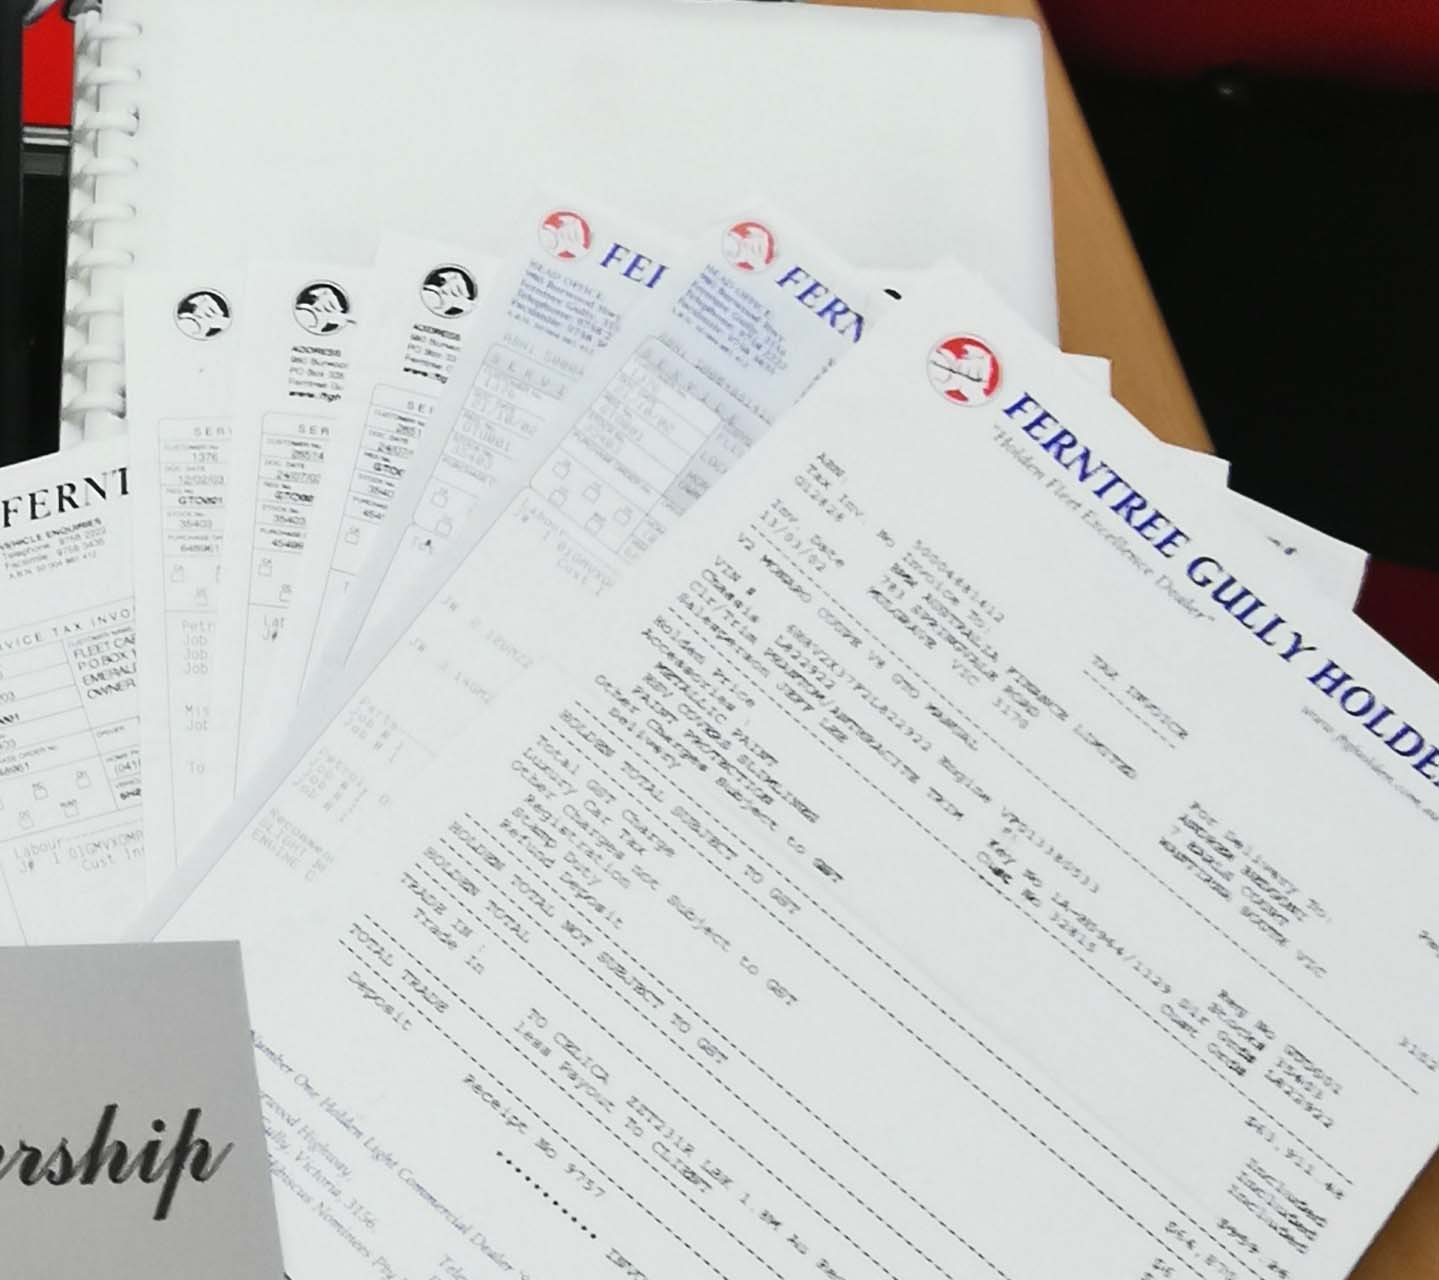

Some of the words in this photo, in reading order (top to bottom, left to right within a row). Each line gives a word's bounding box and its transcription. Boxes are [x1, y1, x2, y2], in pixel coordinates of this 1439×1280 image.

[51, 623, 83, 637] TAX
[1002, 391, 1191, 559] FERNTREE
[1186, 556, 1317, 663] GULLY
[1306, 659, 1439, 788] HOLDE
[506, 807, 557, 849] Stamp
[562, 850, 603, 887] Duty
[518, 793, 631, 889] Registration
[522, 746, 578, 796] Luxury
[583, 799, 613, 825] Car
[619, 827, 647, 857] Tax
[536, 733, 580, 776] Total
[586, 778, 617, 805] GST
[621, 808, 676, 858] Charge
[620, 760, 664, 803] TOTAL
[670, 805, 739, 861] SUBJECT
[743, 863, 764, 885] TO
[769, 887, 802, 915] GST
[348, 922, 393, 968] TOTAL
[401, 968, 449, 1014] TRADE
[462, 1073, 529, 1135] Receipt
[564, 1162, 606, 1198] 9757
